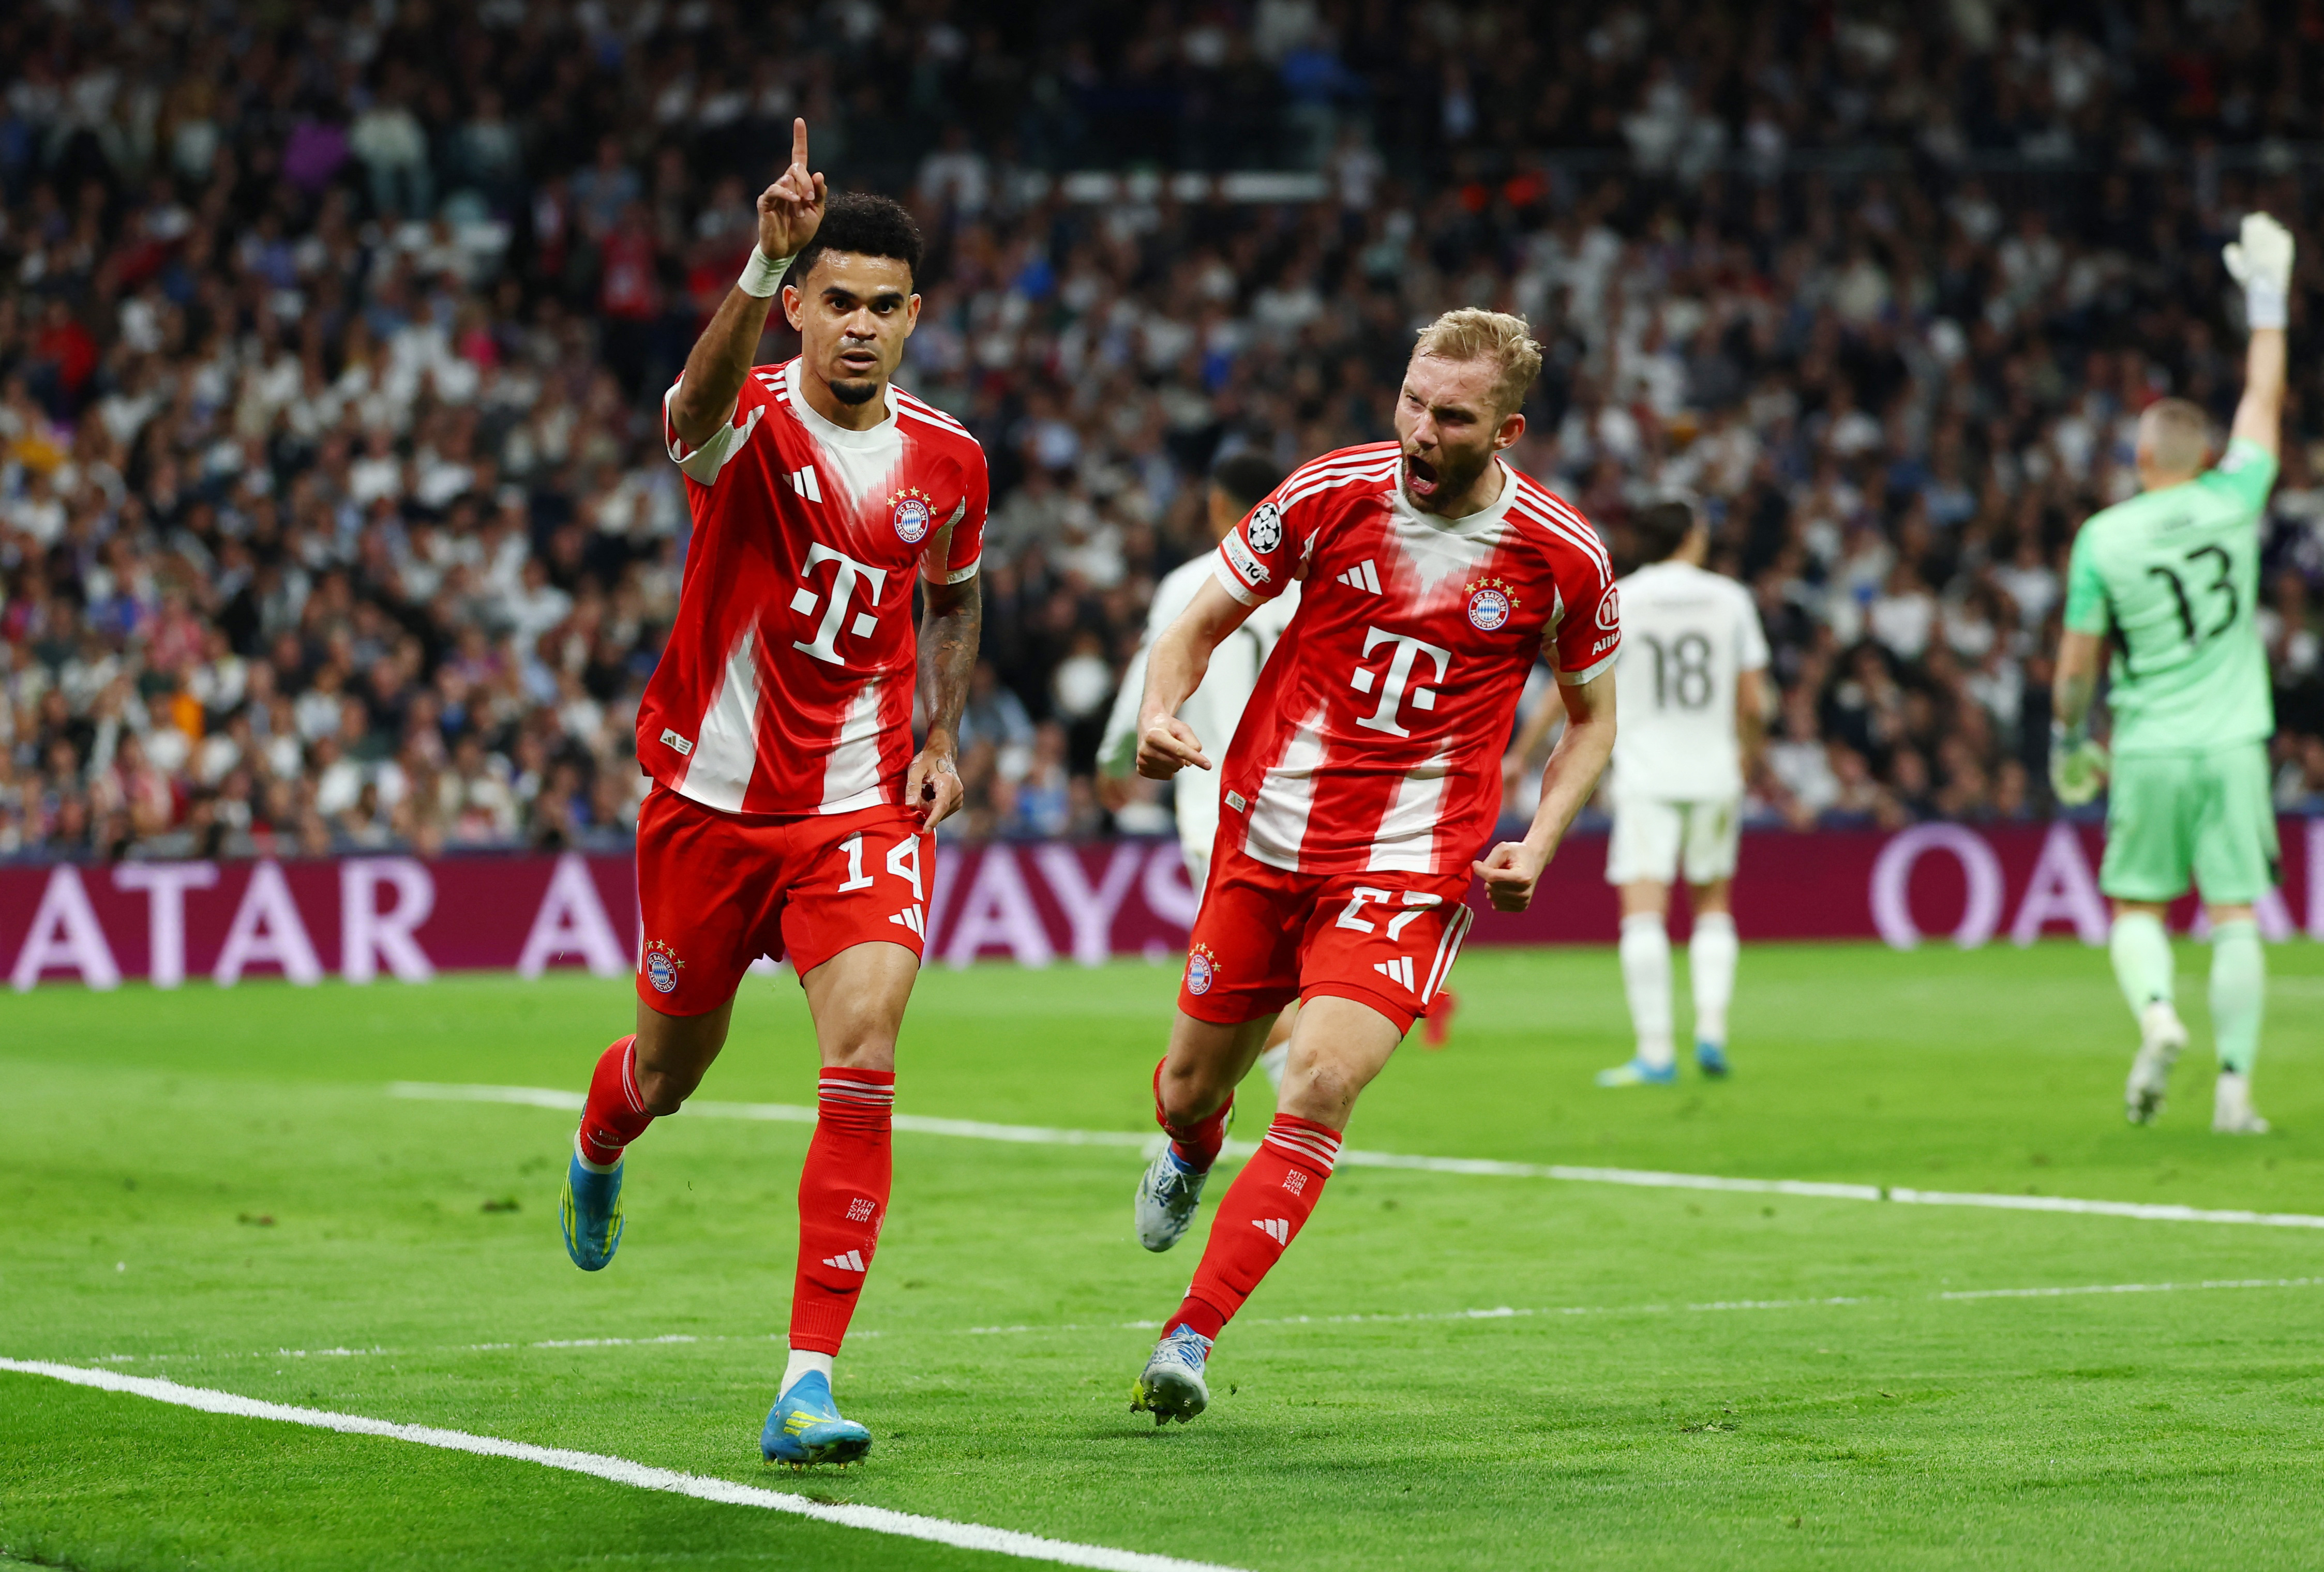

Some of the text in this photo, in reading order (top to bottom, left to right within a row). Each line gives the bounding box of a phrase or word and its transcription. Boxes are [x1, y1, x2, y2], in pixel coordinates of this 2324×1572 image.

[897, 502, 926, 521] FC BAYERN
[2147, 541, 2239, 642] 13
[789, 541, 888, 667] T
[1474, 592, 1506, 612] FC BAYERN
[1638, 630, 1713, 711] 18
[1350, 626, 1451, 738] T
[837, 831, 924, 902] 14
[1335, 886, 1443, 942] 27
[653, 955, 674, 974] BAYERN
[1285, 1176, 1305, 1191] SAN
[1288, 1169, 1308, 1184] MIA
[1282, 1182, 1300, 1197] MIA
[849, 1204, 872, 1216] SAN
[852, 1197, 876, 1210] MIA
[845, 1211, 868, 1223] MIA
